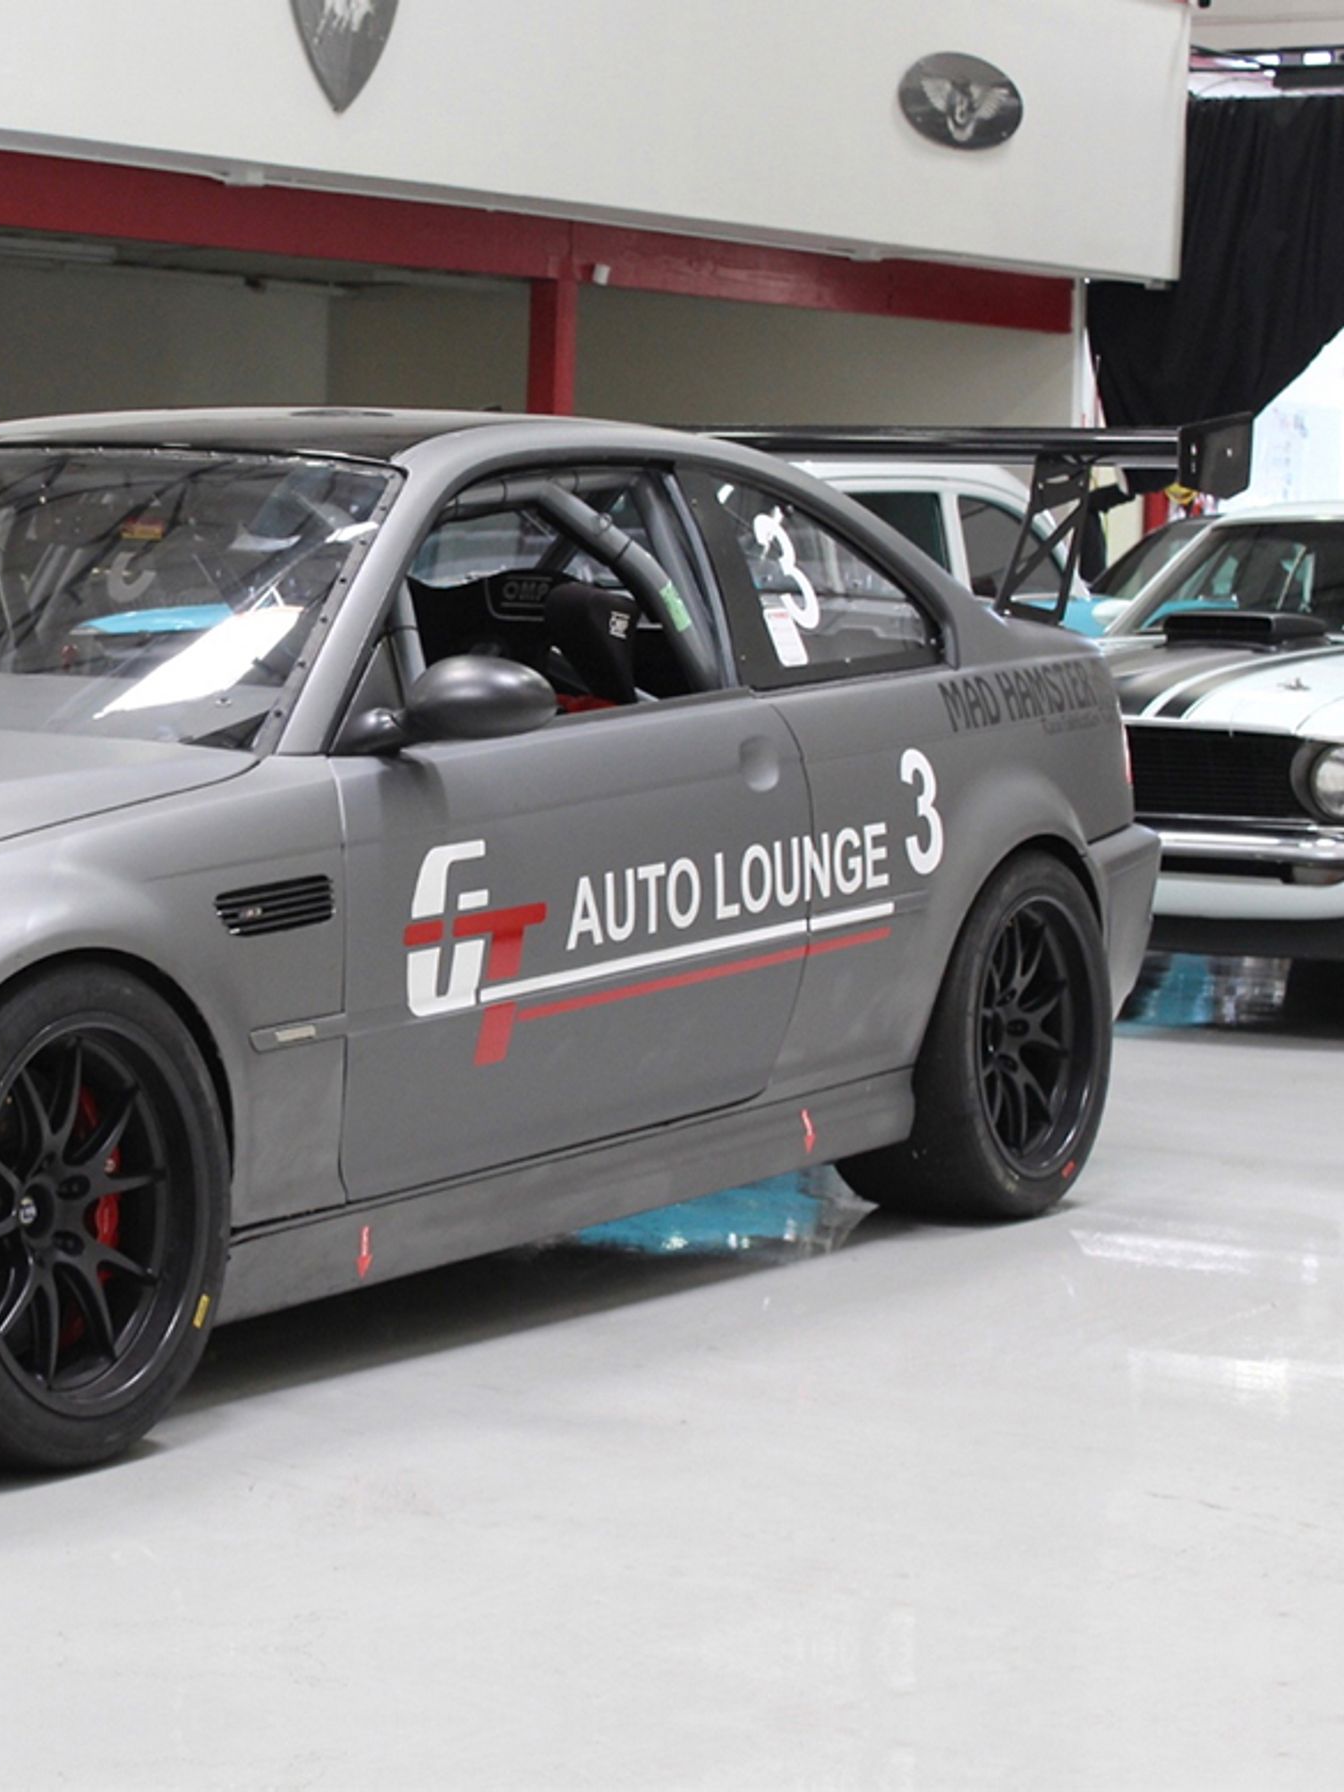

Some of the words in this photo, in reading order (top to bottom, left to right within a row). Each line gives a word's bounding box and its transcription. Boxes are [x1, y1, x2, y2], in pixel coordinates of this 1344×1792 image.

[752, 508, 820, 630] 3
[937, 674, 1001, 733] MAD
[995, 659, 1098, 722] HAMSTER
[899, 747, 945, 876] 3
[403, 838, 548, 1067] GT
[566, 856, 701, 951] AUTO
[714, 821, 890, 920] LOUNGE
